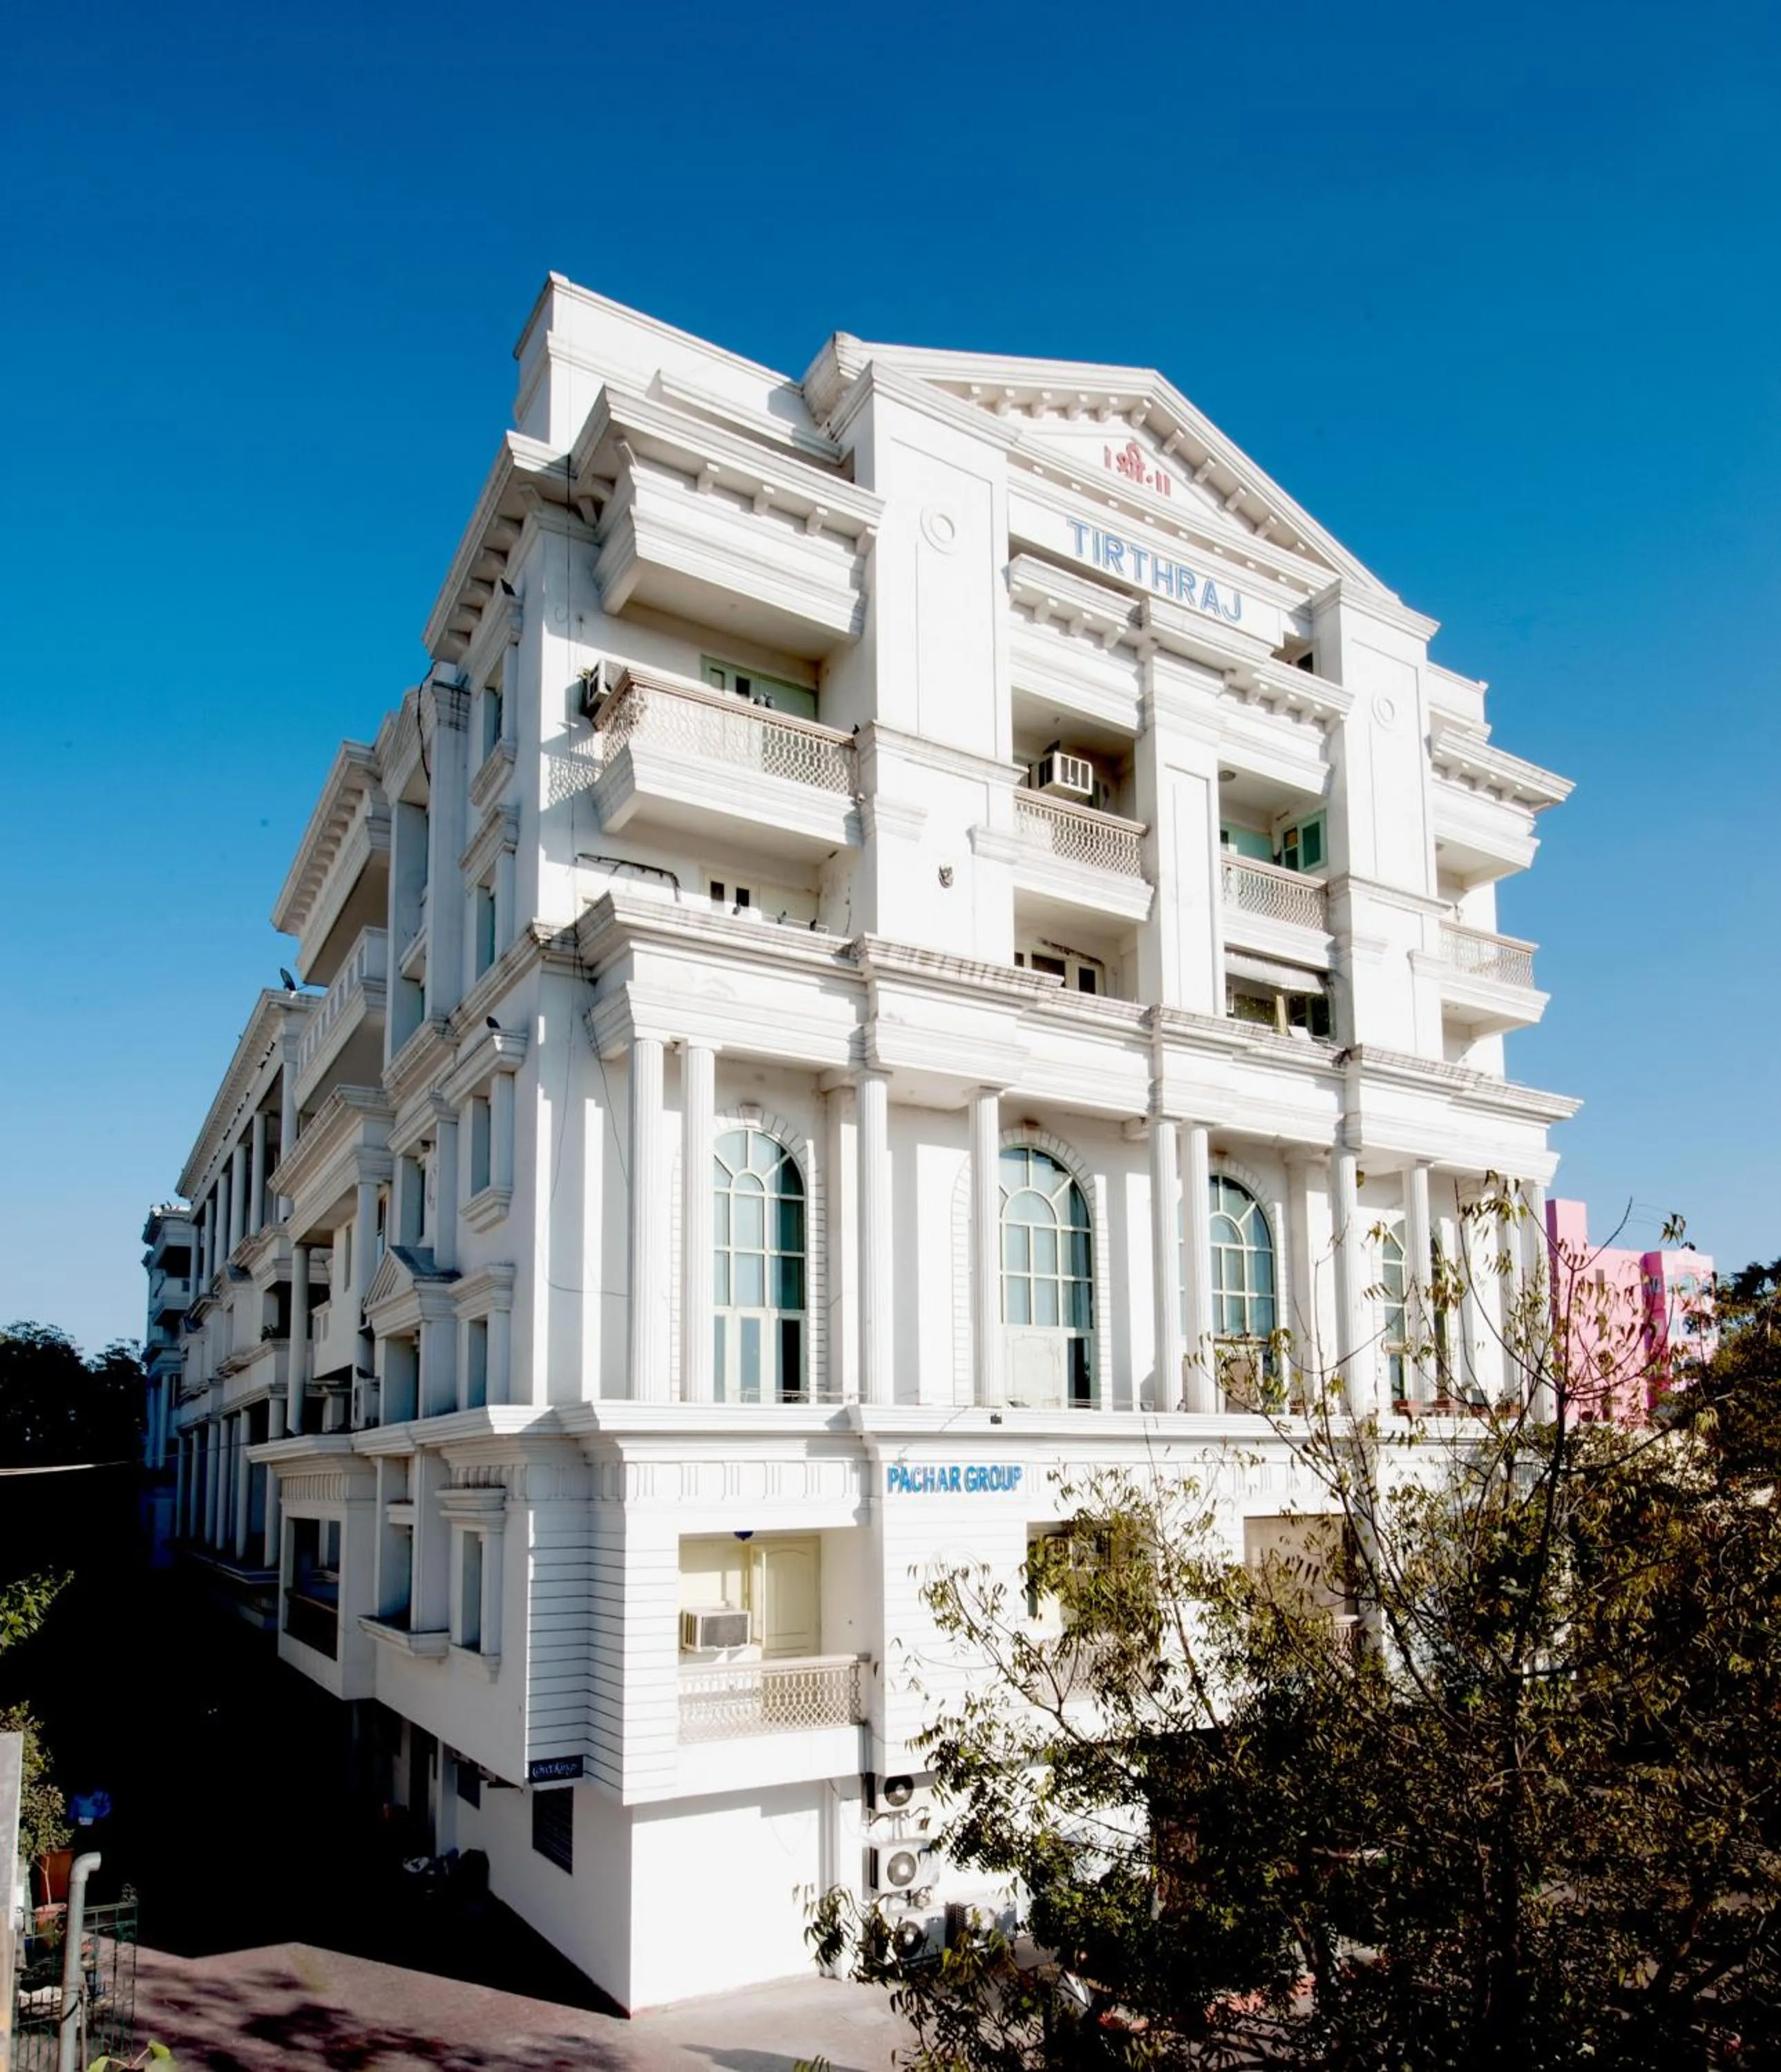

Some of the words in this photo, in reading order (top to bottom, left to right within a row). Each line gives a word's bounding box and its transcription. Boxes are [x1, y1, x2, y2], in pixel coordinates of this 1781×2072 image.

[1068, 519, 1241, 622] TIRTHRAJ
[887, 1466, 962, 1493] PACHAR
[964, 1465, 1022, 1492] GROUP
